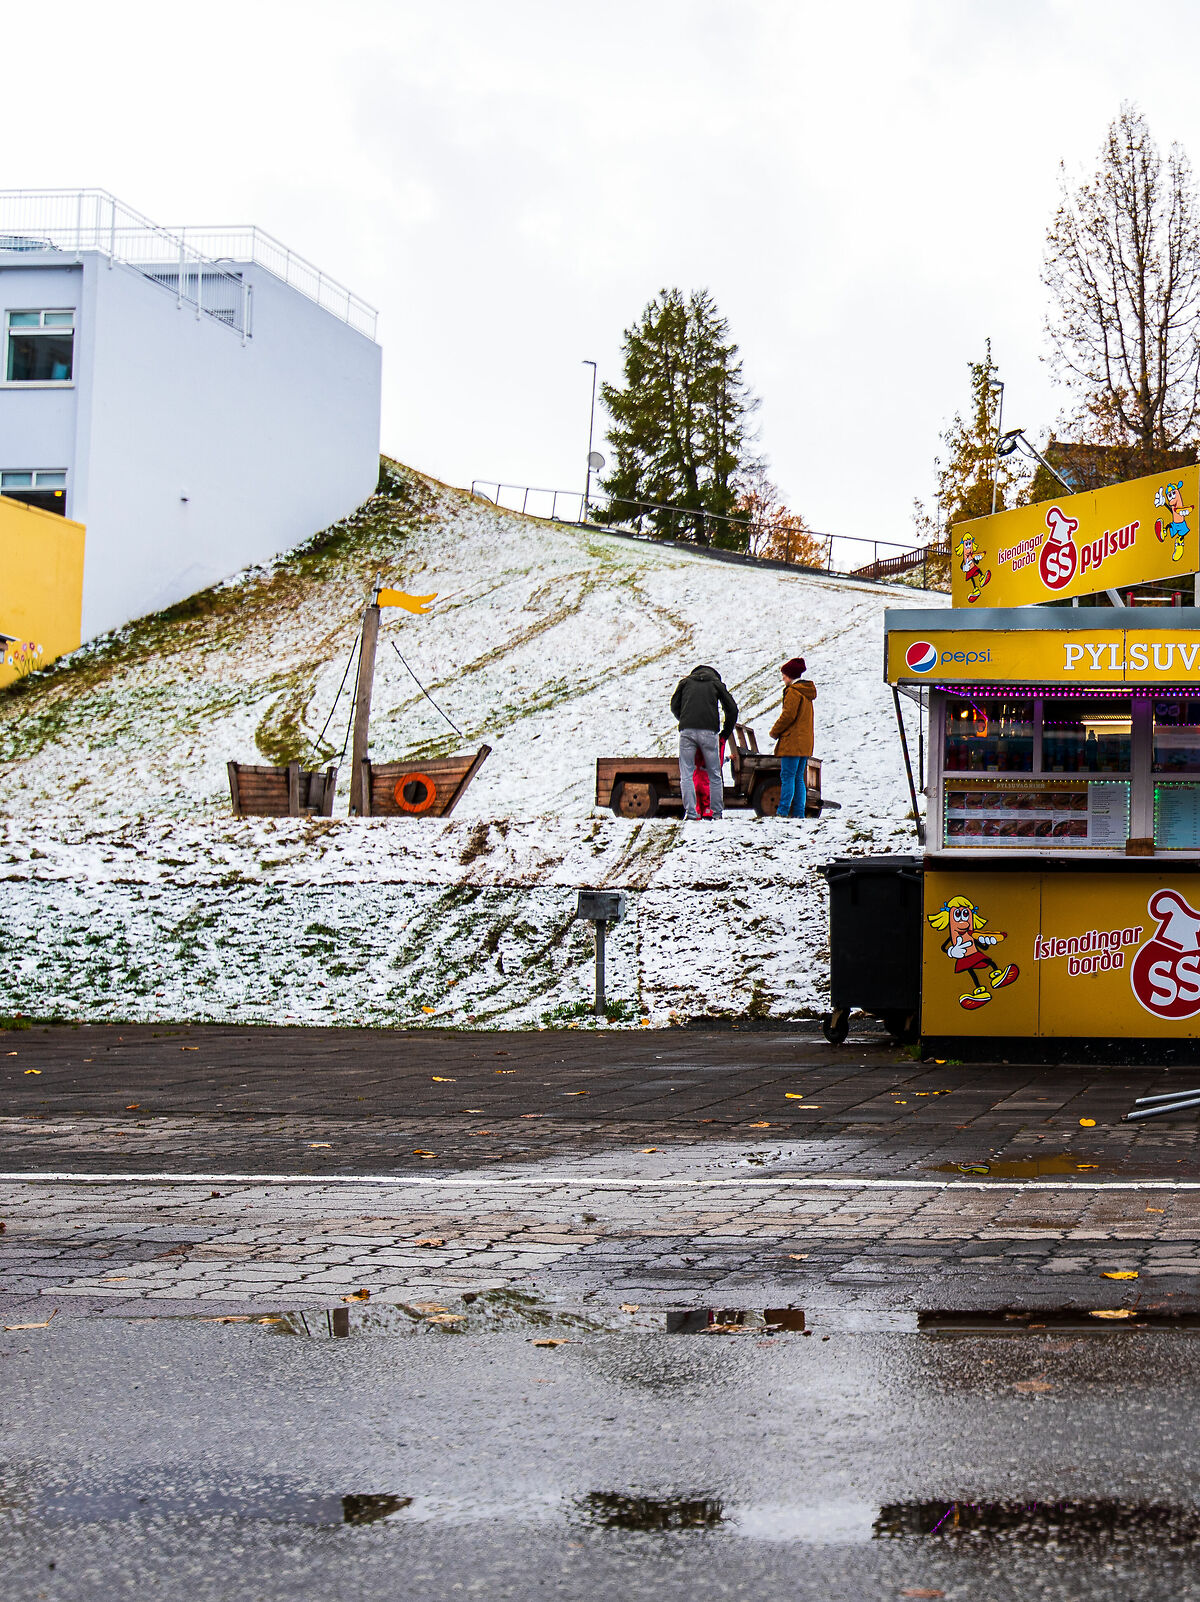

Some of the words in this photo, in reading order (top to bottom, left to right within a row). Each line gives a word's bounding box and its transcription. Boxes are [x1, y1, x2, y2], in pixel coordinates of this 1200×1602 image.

[1012, 551, 1036, 572] borða
[1046, 546, 1073, 583] SS
[1080, 520, 1140, 575] pylsur
[941, 648, 992, 666] pepsi
[1033, 926, 1143, 961] Íslendingar
[1068, 948, 1124, 976] borða
